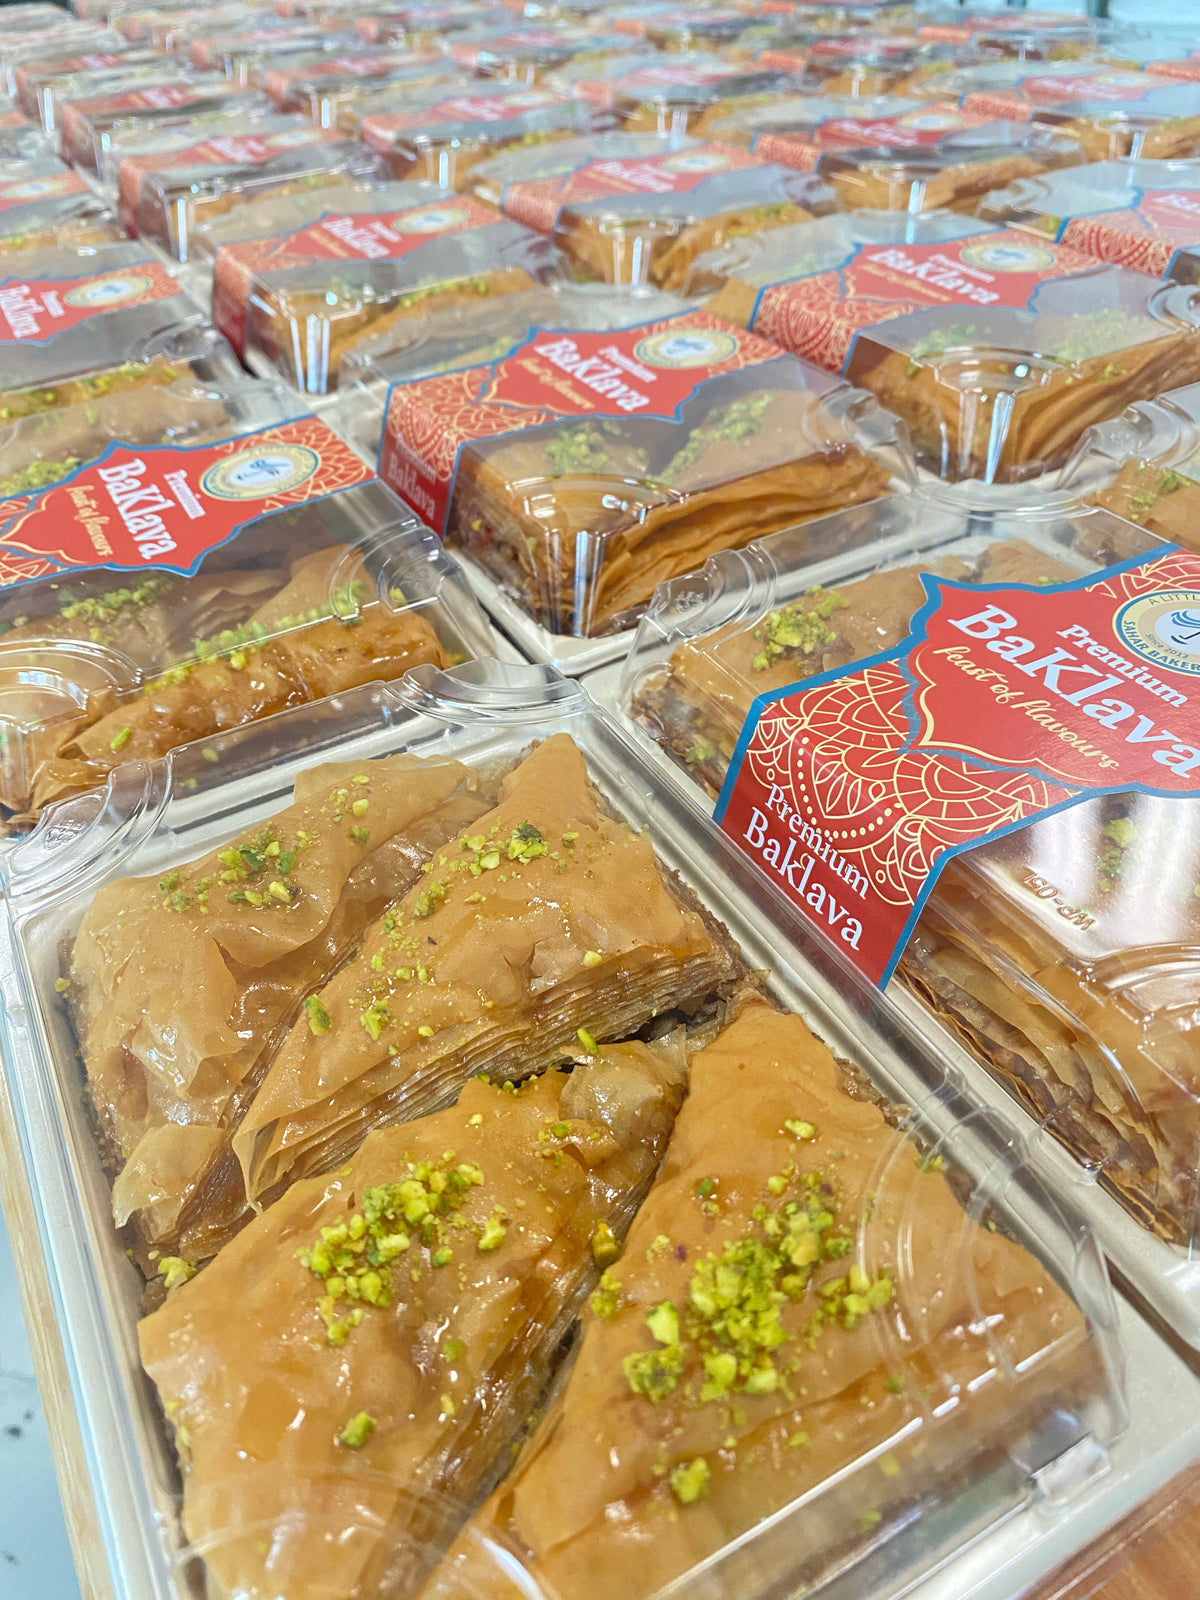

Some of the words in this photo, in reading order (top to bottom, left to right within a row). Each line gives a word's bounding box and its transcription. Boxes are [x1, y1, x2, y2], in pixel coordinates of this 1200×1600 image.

[97, 458, 178, 560] BaKlava
[1056, 624, 1188, 708] Premium
[1123, 621, 1149, 650] SAHAR
[1165, 648, 1189, 659] 2012
[932, 646, 1009, 684] feast
[989, 684, 1025, 704] of
[1010, 699, 1120, 770] flavours
[948, 604, 1200, 778] BaKlava
[743, 806, 864, 951] Baklava
[764, 783, 870, 900] Premium
